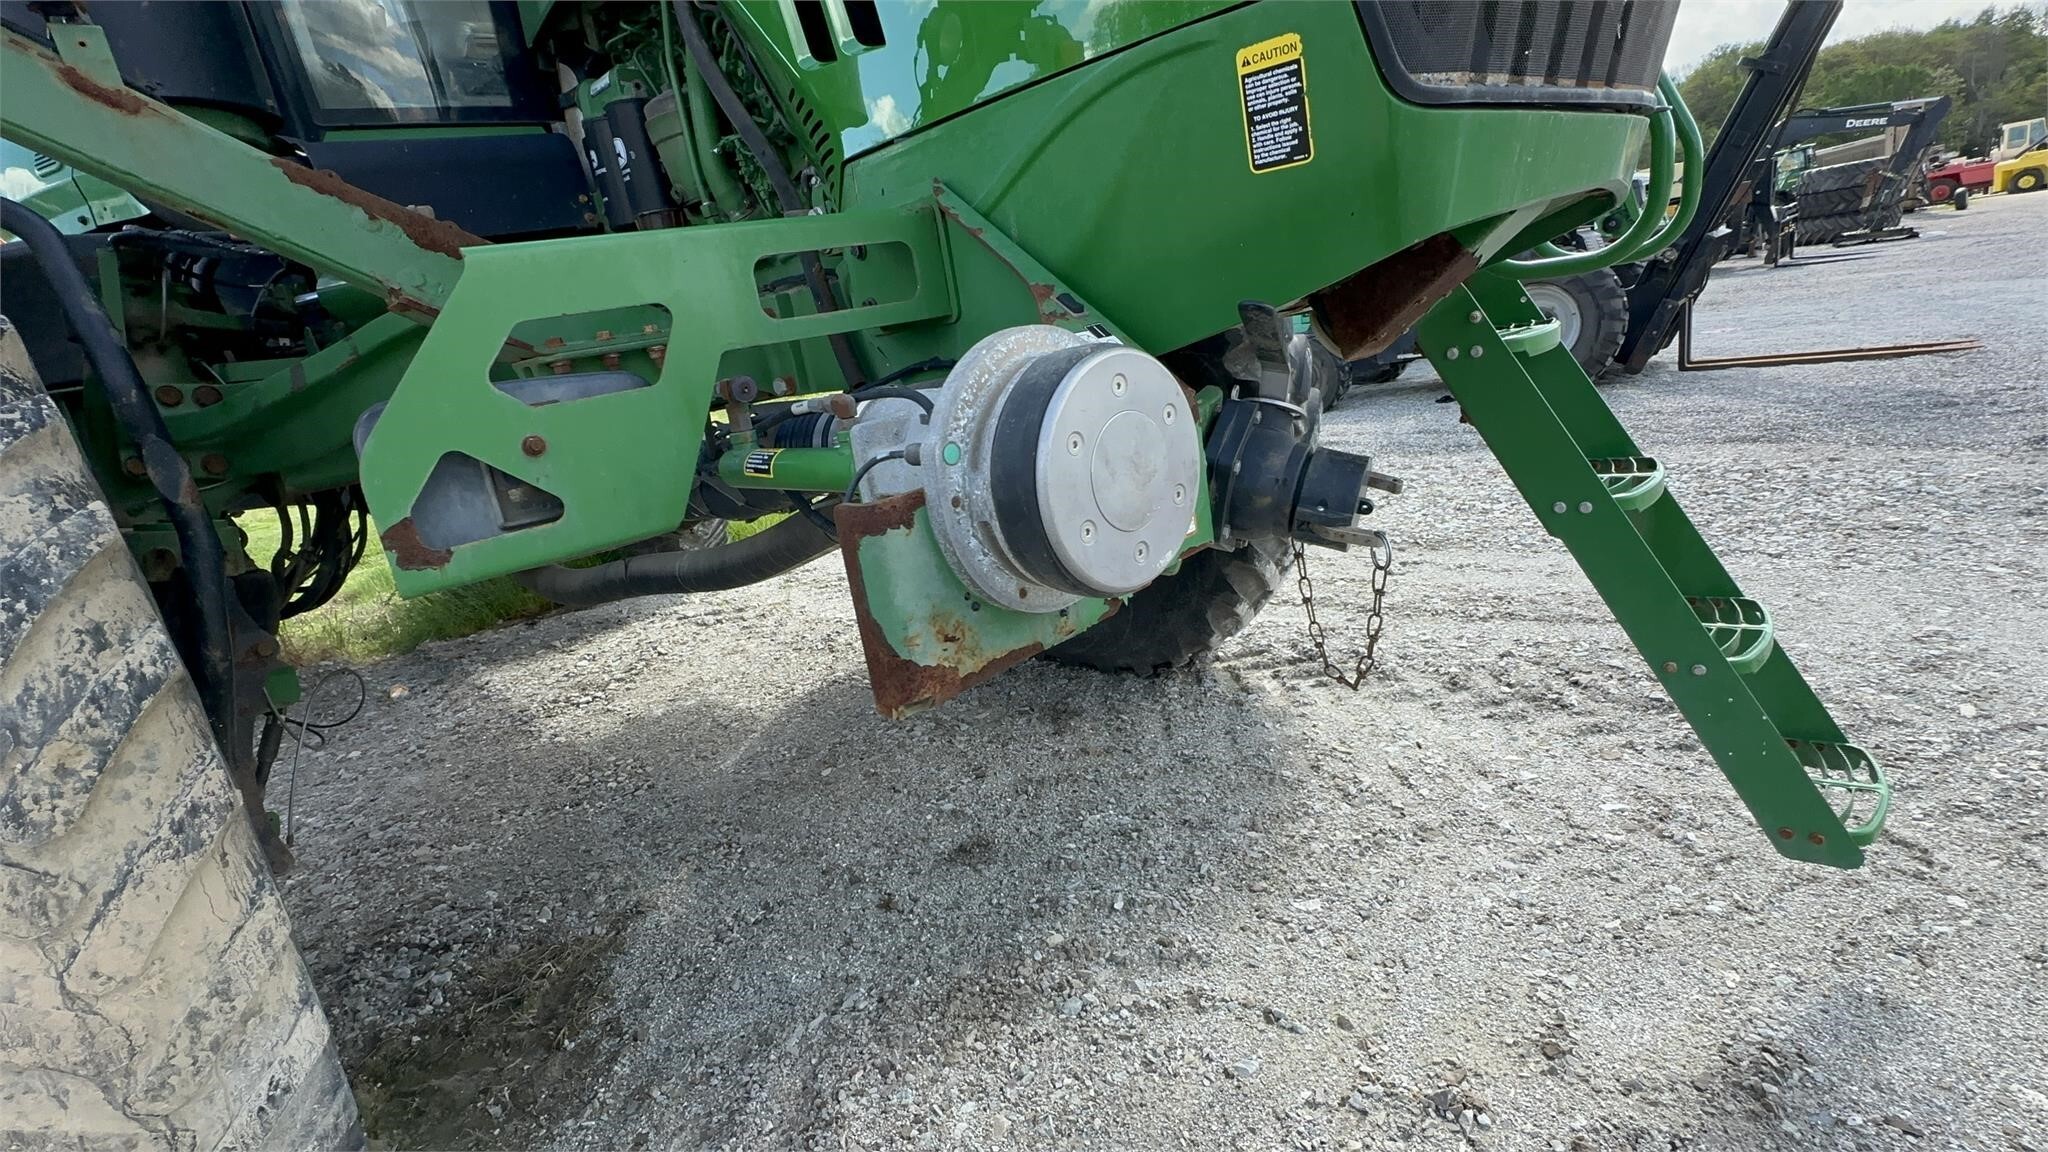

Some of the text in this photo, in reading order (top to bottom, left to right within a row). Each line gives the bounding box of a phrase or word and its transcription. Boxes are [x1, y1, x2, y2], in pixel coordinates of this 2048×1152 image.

[1252, 42, 1297, 64] CAUTION
[1244, 64, 1298, 84] Agricultural chemicals
[1262, 111, 1278, 120] AVOID
[1279, 106, 1299, 115] INJURY
[1256, 122, 1270, 130] Select
[1280, 117, 1292, 125] right
[1845, 117, 1888, 128] DEERE
[1251, 128, 1272, 137] chemical
[1285, 128, 1298, 136] apply
[1269, 147, 1291, 156] chemical
